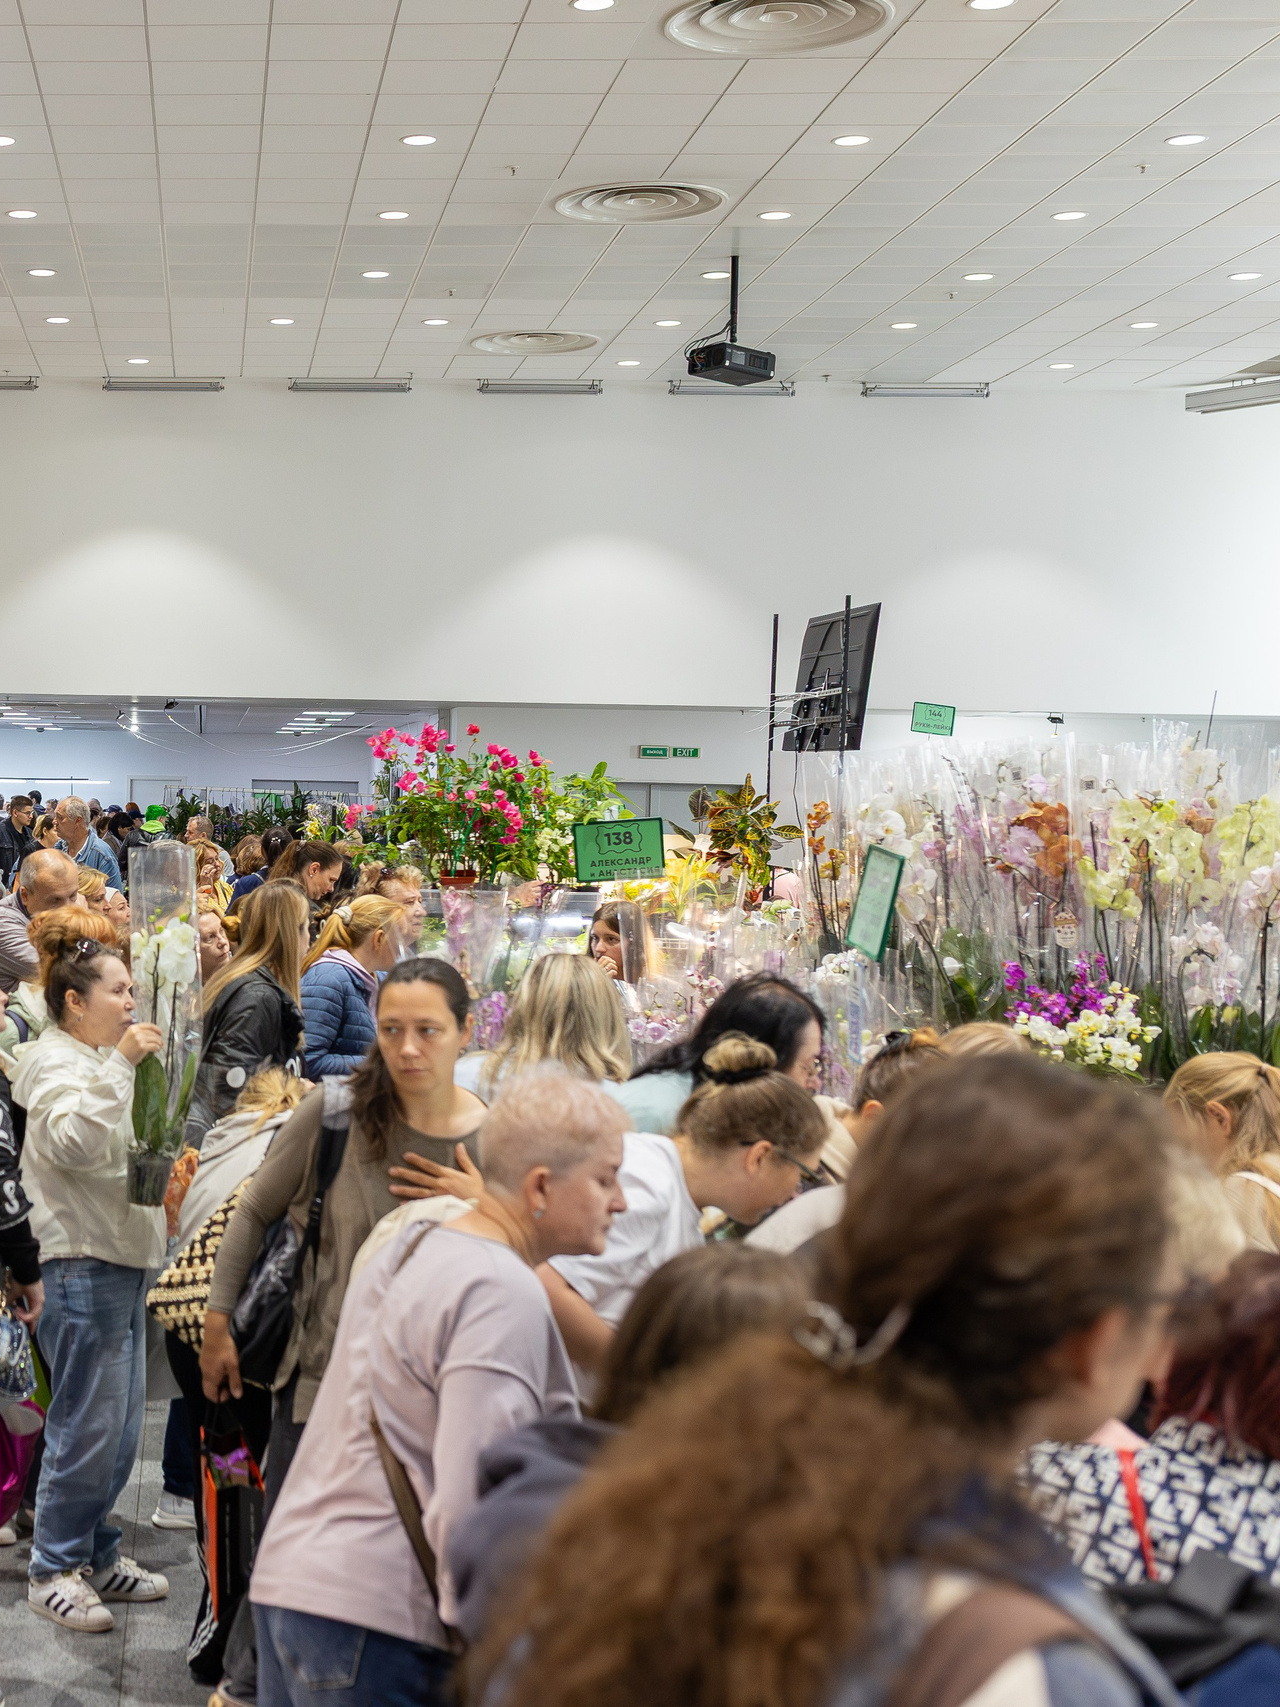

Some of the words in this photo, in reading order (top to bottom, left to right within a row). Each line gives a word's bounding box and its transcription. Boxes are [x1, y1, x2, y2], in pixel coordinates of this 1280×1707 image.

[928, 709, 942, 717] 144
[676, 748, 695, 757] EXIT
[604, 831, 633, 846] 138
[590, 857, 652, 867] АЛЕКСАНДР
[598, 865, 661, 878] АНАСТАСИЯ
